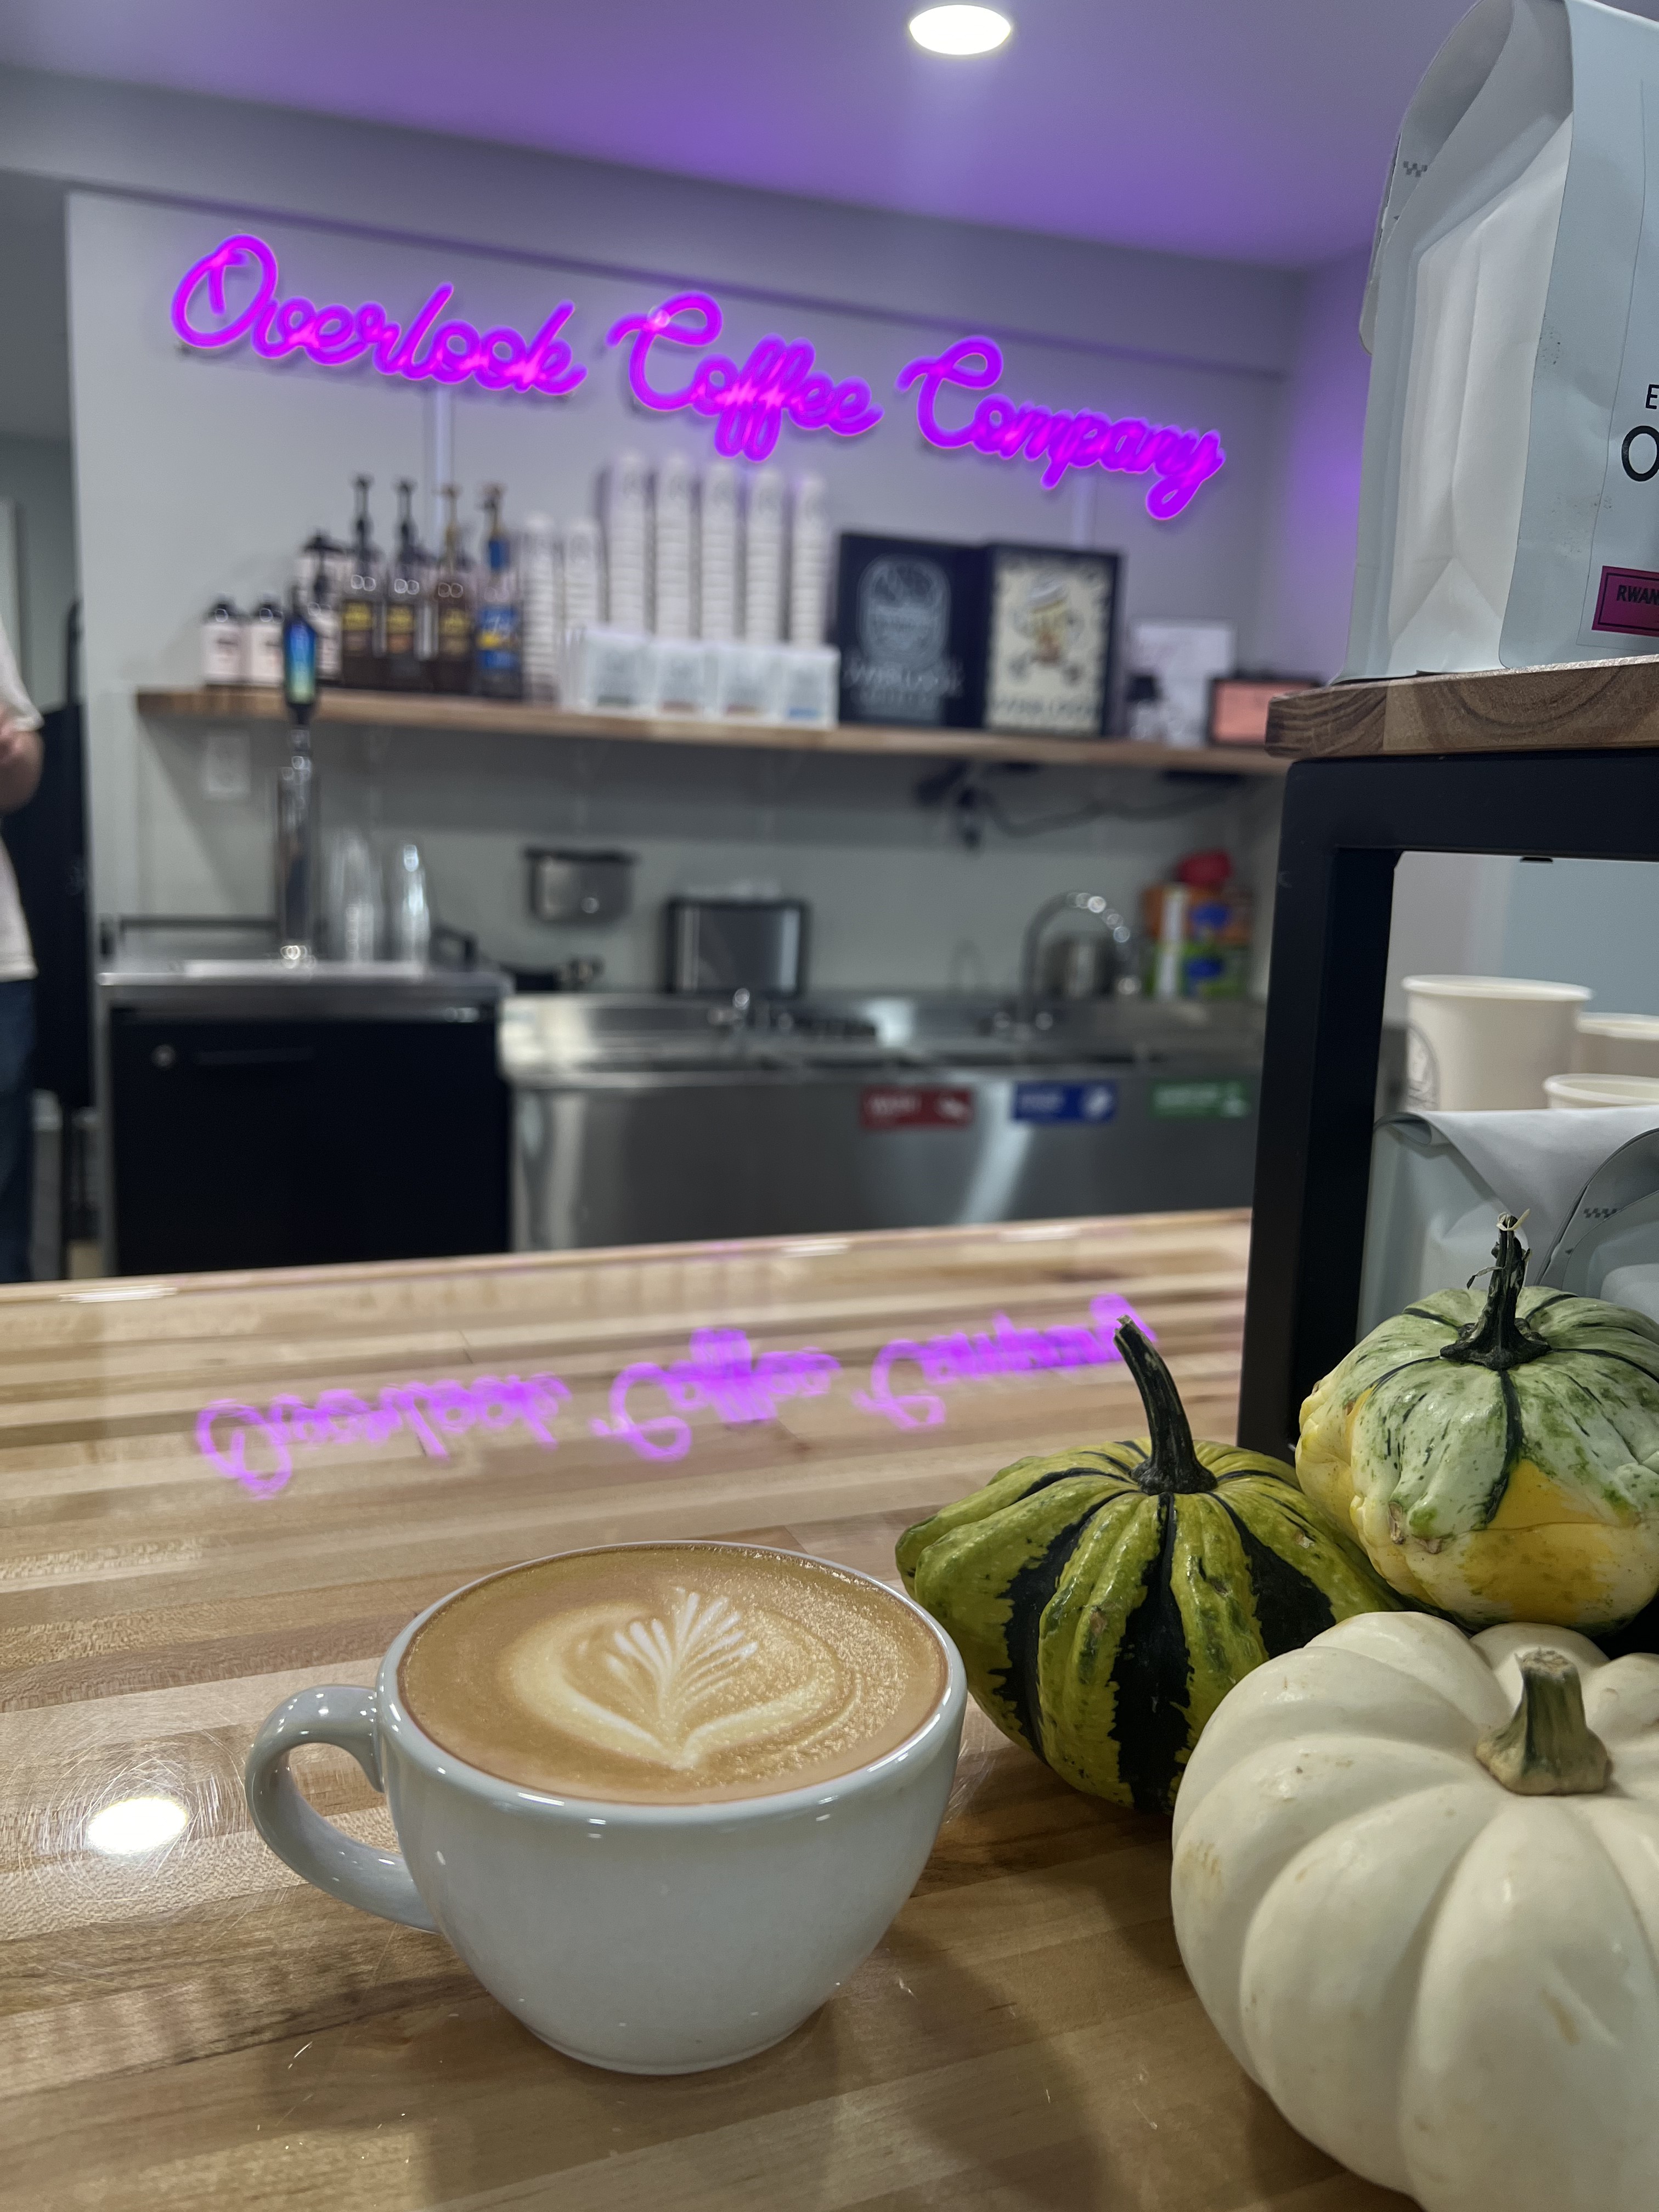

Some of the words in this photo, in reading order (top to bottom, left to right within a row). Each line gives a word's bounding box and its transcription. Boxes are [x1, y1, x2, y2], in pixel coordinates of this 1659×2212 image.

[171, 234, 587, 395] Overlook
[606, 291, 883, 462] Coffee
[896, 336, 1226, 521] Company
